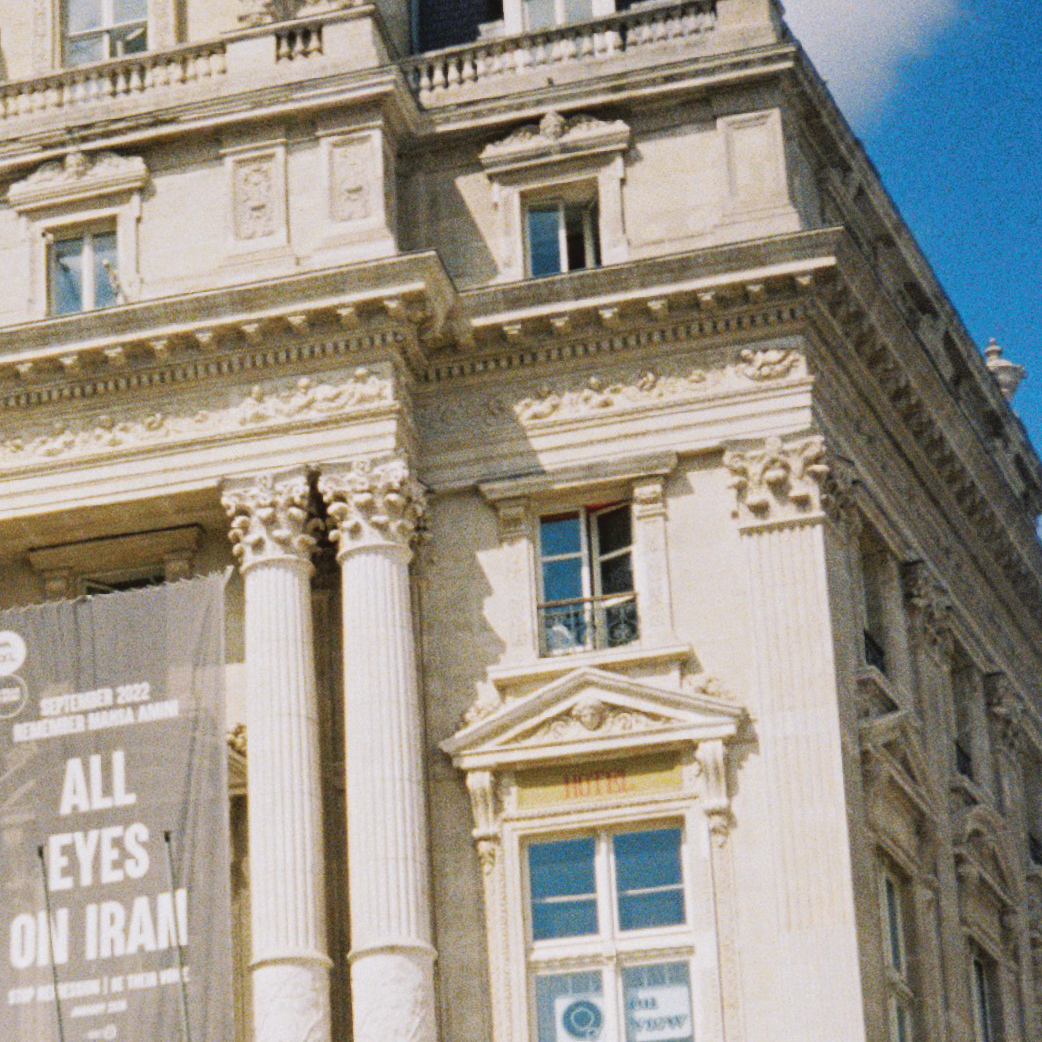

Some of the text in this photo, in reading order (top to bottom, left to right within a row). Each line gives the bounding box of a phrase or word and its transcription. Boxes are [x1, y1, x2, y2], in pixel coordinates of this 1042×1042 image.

[116, 682, 151, 705] 2022
[60, 750, 137, 816] ALL
[48, 822, 150, 892] EYES
[9, 888, 188, 970] ON IRAN
